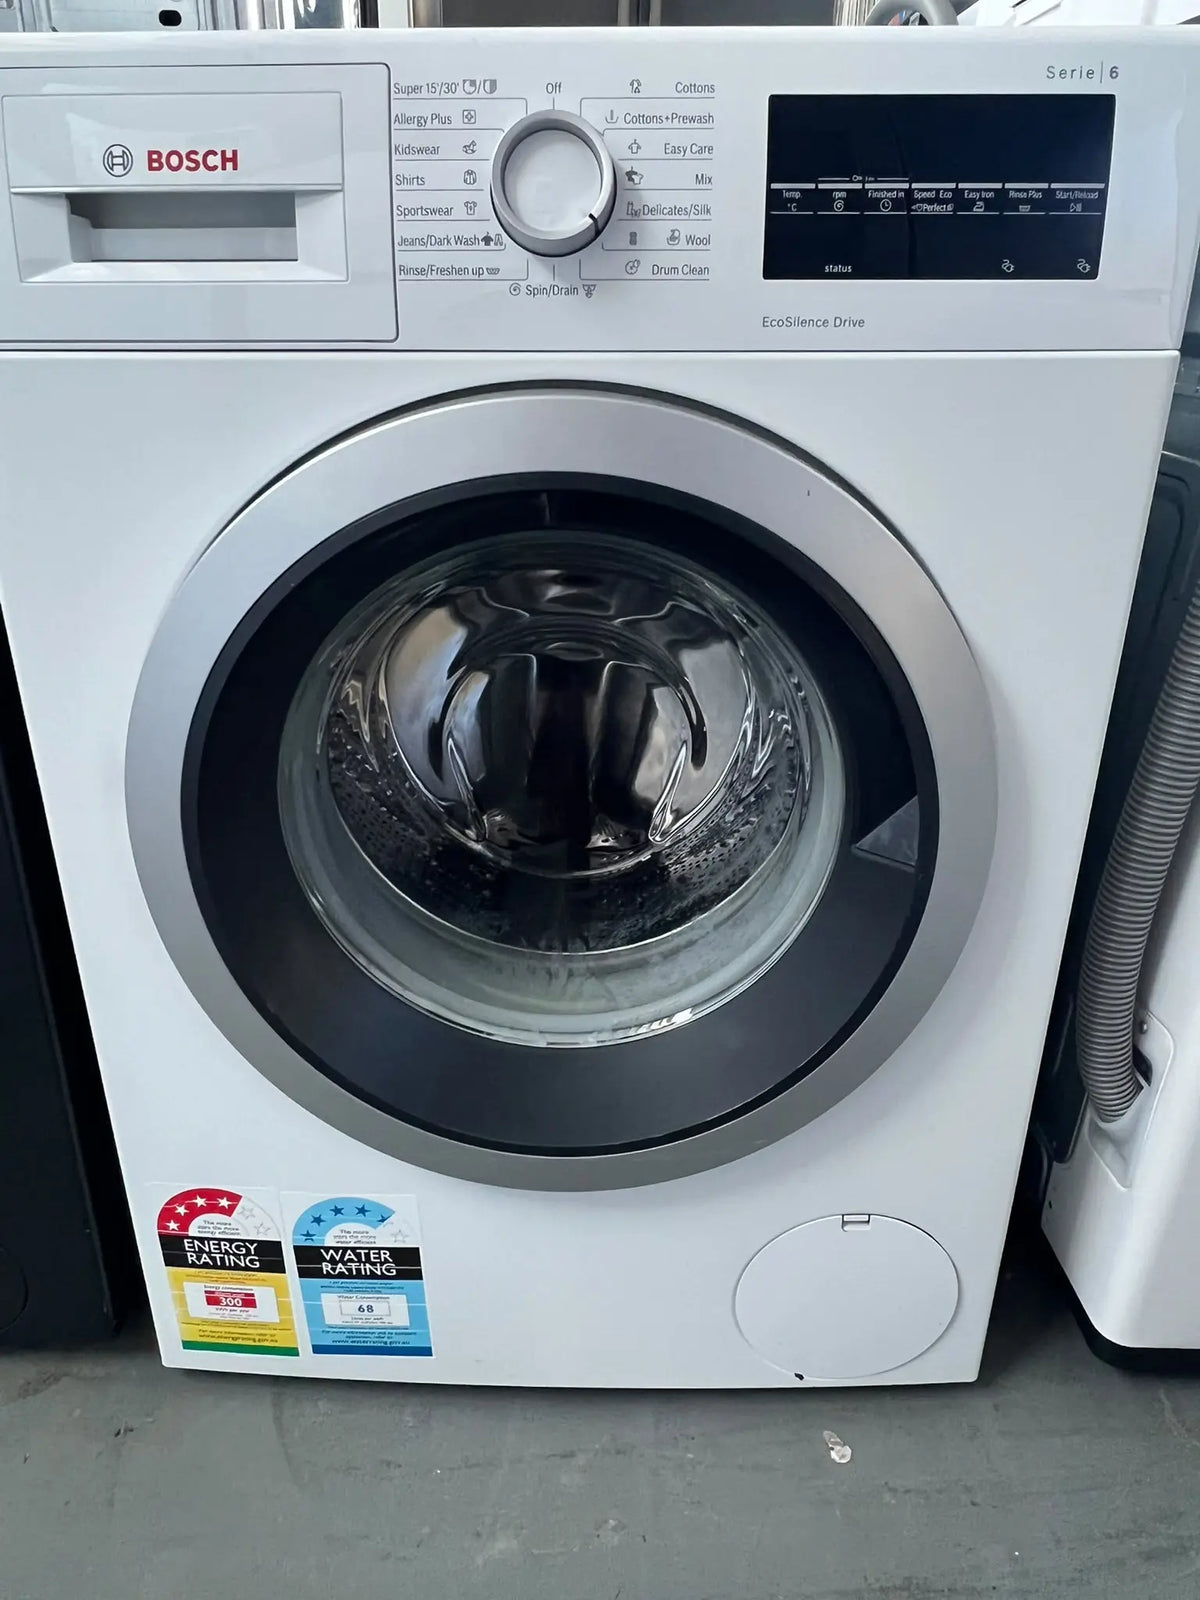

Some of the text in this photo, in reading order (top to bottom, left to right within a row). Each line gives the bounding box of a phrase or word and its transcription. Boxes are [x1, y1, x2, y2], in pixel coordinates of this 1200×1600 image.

[1046, 65, 1119, 80] Serie 6
[393, 82, 424, 96] Super
[546, 82, 562, 95] Off
[675, 82, 716, 94] Cottons
[393, 113, 453, 127] Allergy Plus
[624, 112, 715, 125] Cottons+Prewash
[394, 144, 440, 155] Kidswear
[664, 143, 714, 157] Easy Care
[147, 149, 239, 172] BOSCH
[395, 174, 426, 186] Shirts
[695, 173, 713, 185] Mix
[832, 191, 847, 200] rpm
[868, 190, 905, 199] Finished in
[913, 190, 936, 200] Speed
[939, 190, 953, 199] Eco
[964, 190, 995, 199] Easy Iron
[1009, 190, 1043, 199] Rinse Plus
[396, 205, 454, 218] Sportswear
[642, 204, 712, 218] Delicates/Silk
[922, 203, 946, 211] Perfect
[397, 234, 480, 248] Jeans/Dark Wash
[685, 234, 711, 246] Wool
[399, 265, 484, 278] Rinse/Freshen up
[652, 264, 710, 275] Drum Clean
[824, 264, 852, 273] status
[525, 284, 579, 299] Spin/Drain
[762, 316, 865, 328] EcoSilence Drive
[184, 1239, 258, 1255] ENERGY
[186, 1252, 260, 1268] RATING
[320, 1249, 393, 1263] WATER
[322, 1262, 397, 1276] RATING
[219, 1297, 242, 1307] 300
[358, 1304, 374, 1313] 68
